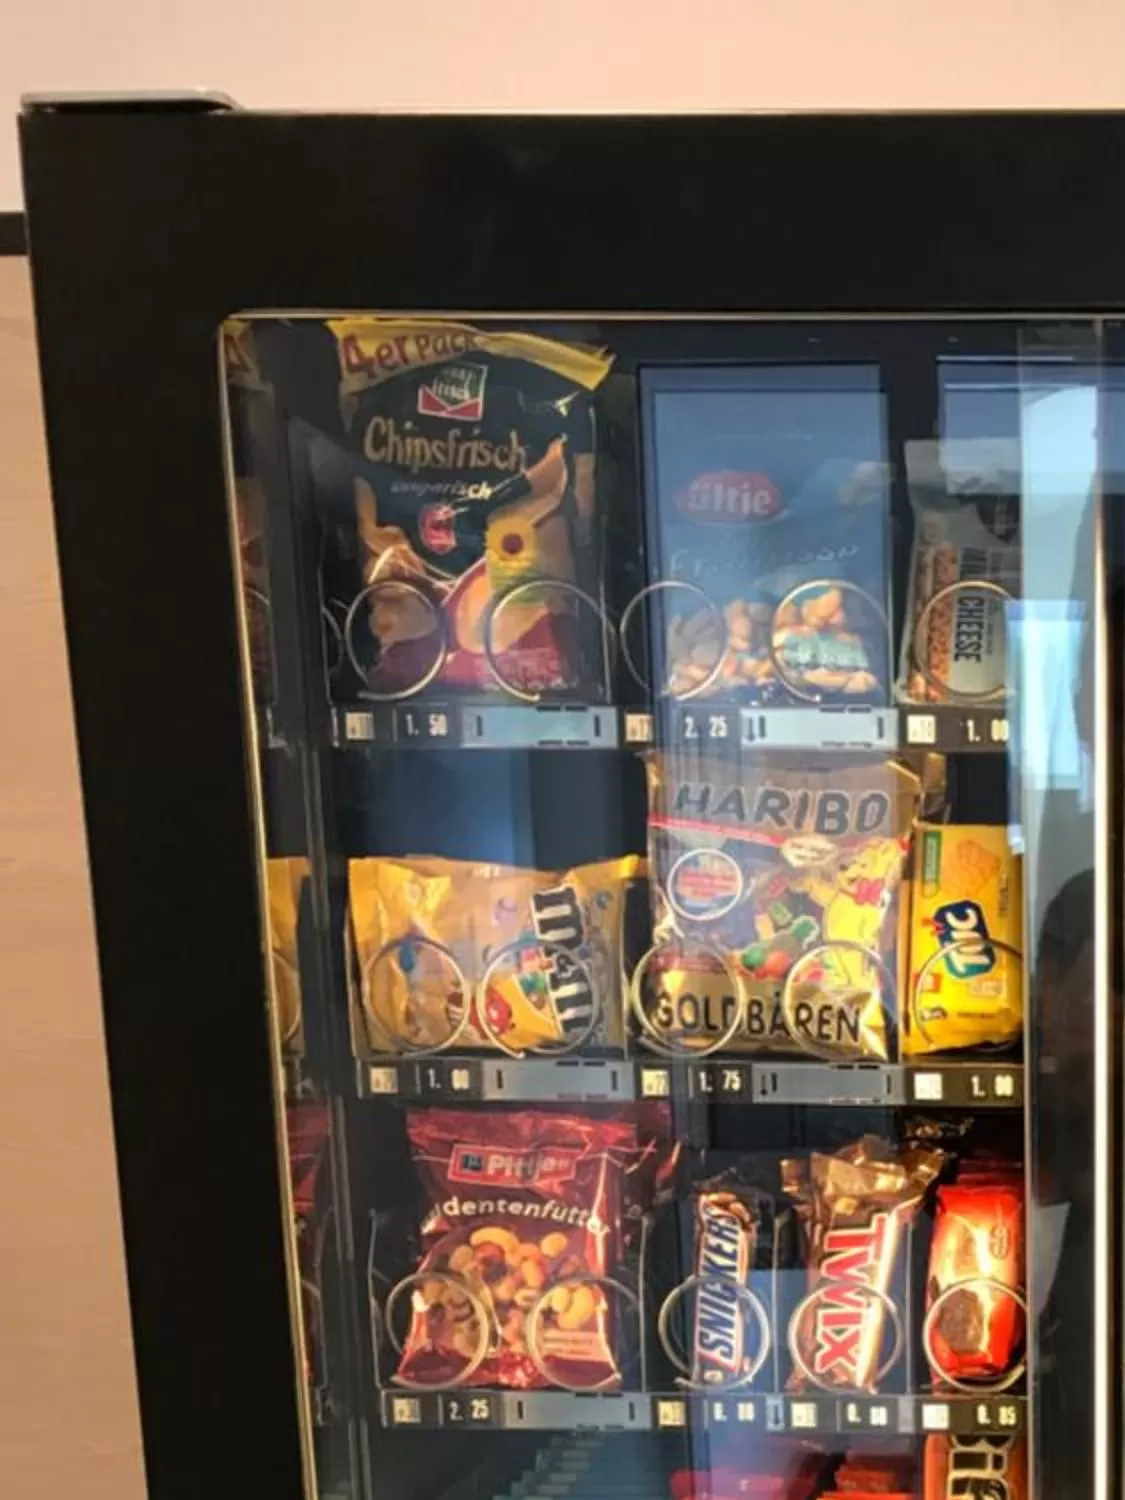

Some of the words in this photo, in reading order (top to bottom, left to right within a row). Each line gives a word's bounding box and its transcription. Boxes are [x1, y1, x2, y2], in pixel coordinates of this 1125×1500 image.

[364, 415, 527, 474] Chipsfrisch
[954, 596, 986, 663] CHEESE
[675, 784, 891, 837] HARIBO
[944, 907, 991, 974] TUC
[814, 1212, 892, 1373] TWIX
